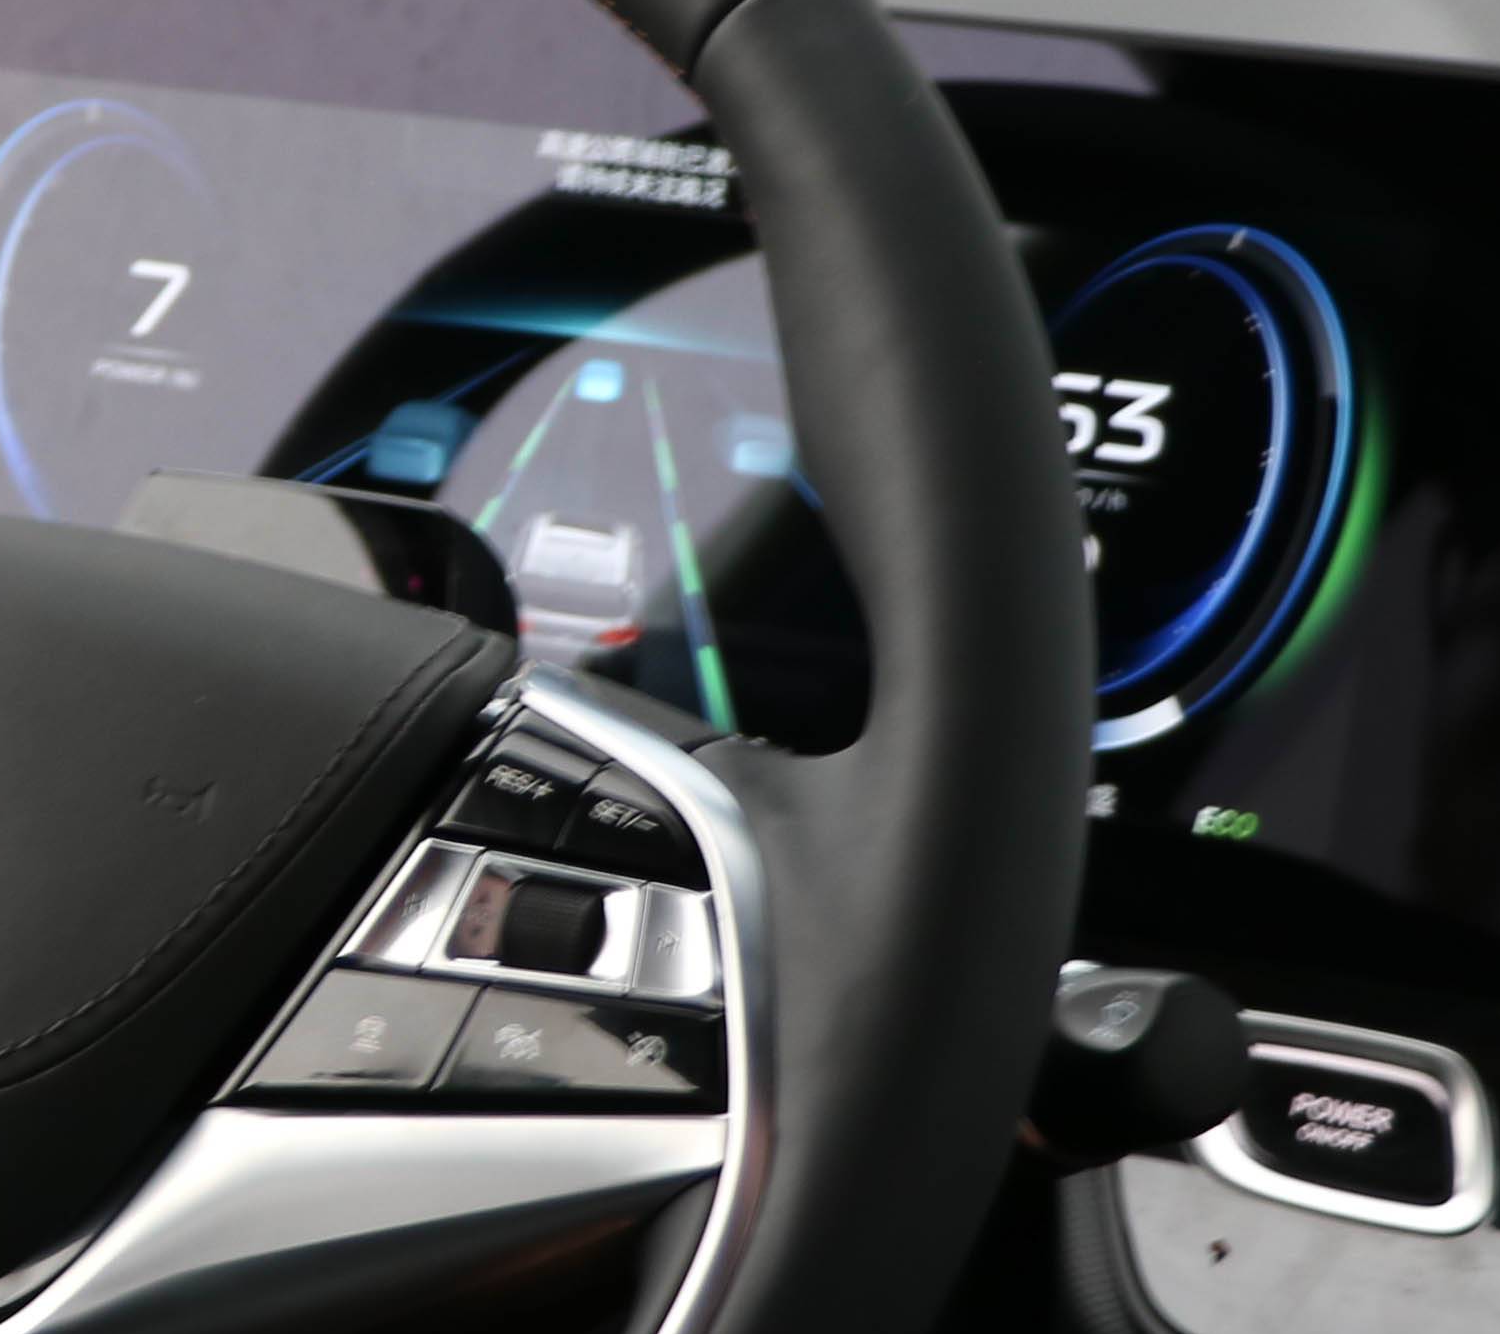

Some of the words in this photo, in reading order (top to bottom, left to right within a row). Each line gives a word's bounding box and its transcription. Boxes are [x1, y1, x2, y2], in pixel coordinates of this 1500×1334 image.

[128, 258, 191, 338] 7
[1051, 372, 1171, 463] 53
[1288, 1092, 1395, 1133] POWER
